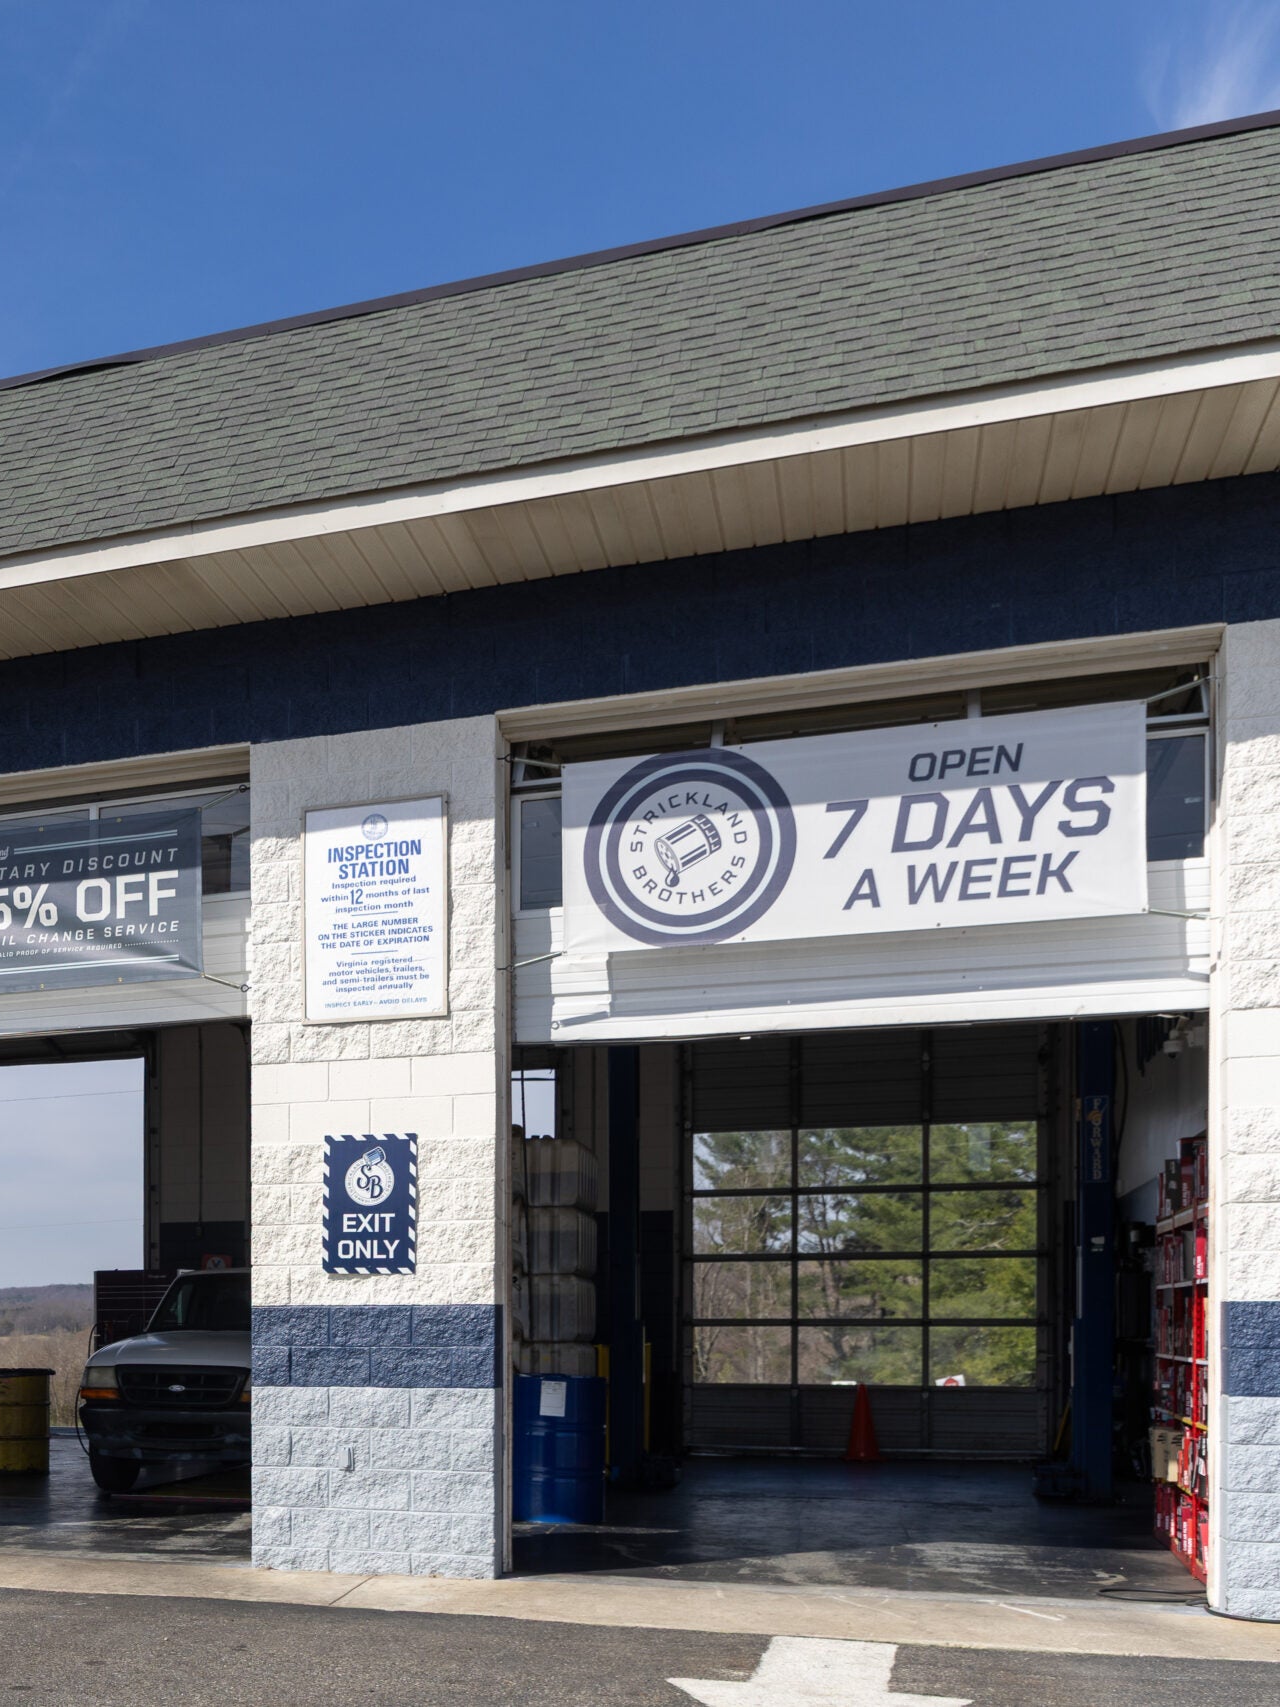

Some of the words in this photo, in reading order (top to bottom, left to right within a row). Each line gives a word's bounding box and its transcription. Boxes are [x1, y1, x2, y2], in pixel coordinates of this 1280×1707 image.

[908, 743, 1024, 782] OPEN
[630, 792, 747, 852] STRICKLAND
[823, 799, 869, 859] 7
[891, 776, 1115, 853] DAYS
[328, 839, 422, 863] INSPECTION
[62, 848, 178, 874] DISCOUNT
[339, 859, 409, 880] STATION
[332, 880, 377, 889] Inspection
[380, 875, 416, 885] required
[632, 856, 746, 904] BROTHERS
[842, 868, 881, 910] A
[907, 851, 1080, 905] WEEK
[76, 869, 179, 922] OFF
[321, 893, 349, 902] within
[350, 888, 364, 905] 12
[366, 889, 399, 898] months
[336, 904, 381, 913] inspection
[384, 900, 413, 908] month
[26, 929, 95, 944] CHANGE
[104, 920, 179, 938] SERVICE
[350, 929, 386, 938] STICKER
[388, 925, 433, 935] INDICATES
[351, 920, 378, 929] LARGE
[381, 917, 418, 926] NUMBER
[86, 943, 122, 951] REQUIRED
[339, 940, 361, 948] DATE
[377, 935, 430, 946] EXPIRATION
[336, 960, 368, 969] Virginia
[371, 956, 413, 966] registered
[335, 984, 375, 993] inspected
[378, 982, 413, 991] annually
[339, 974, 394, 984] semi-trailers
[342, 1213, 396, 1232] EXIT
[337, 1239, 400, 1259] ONLY
